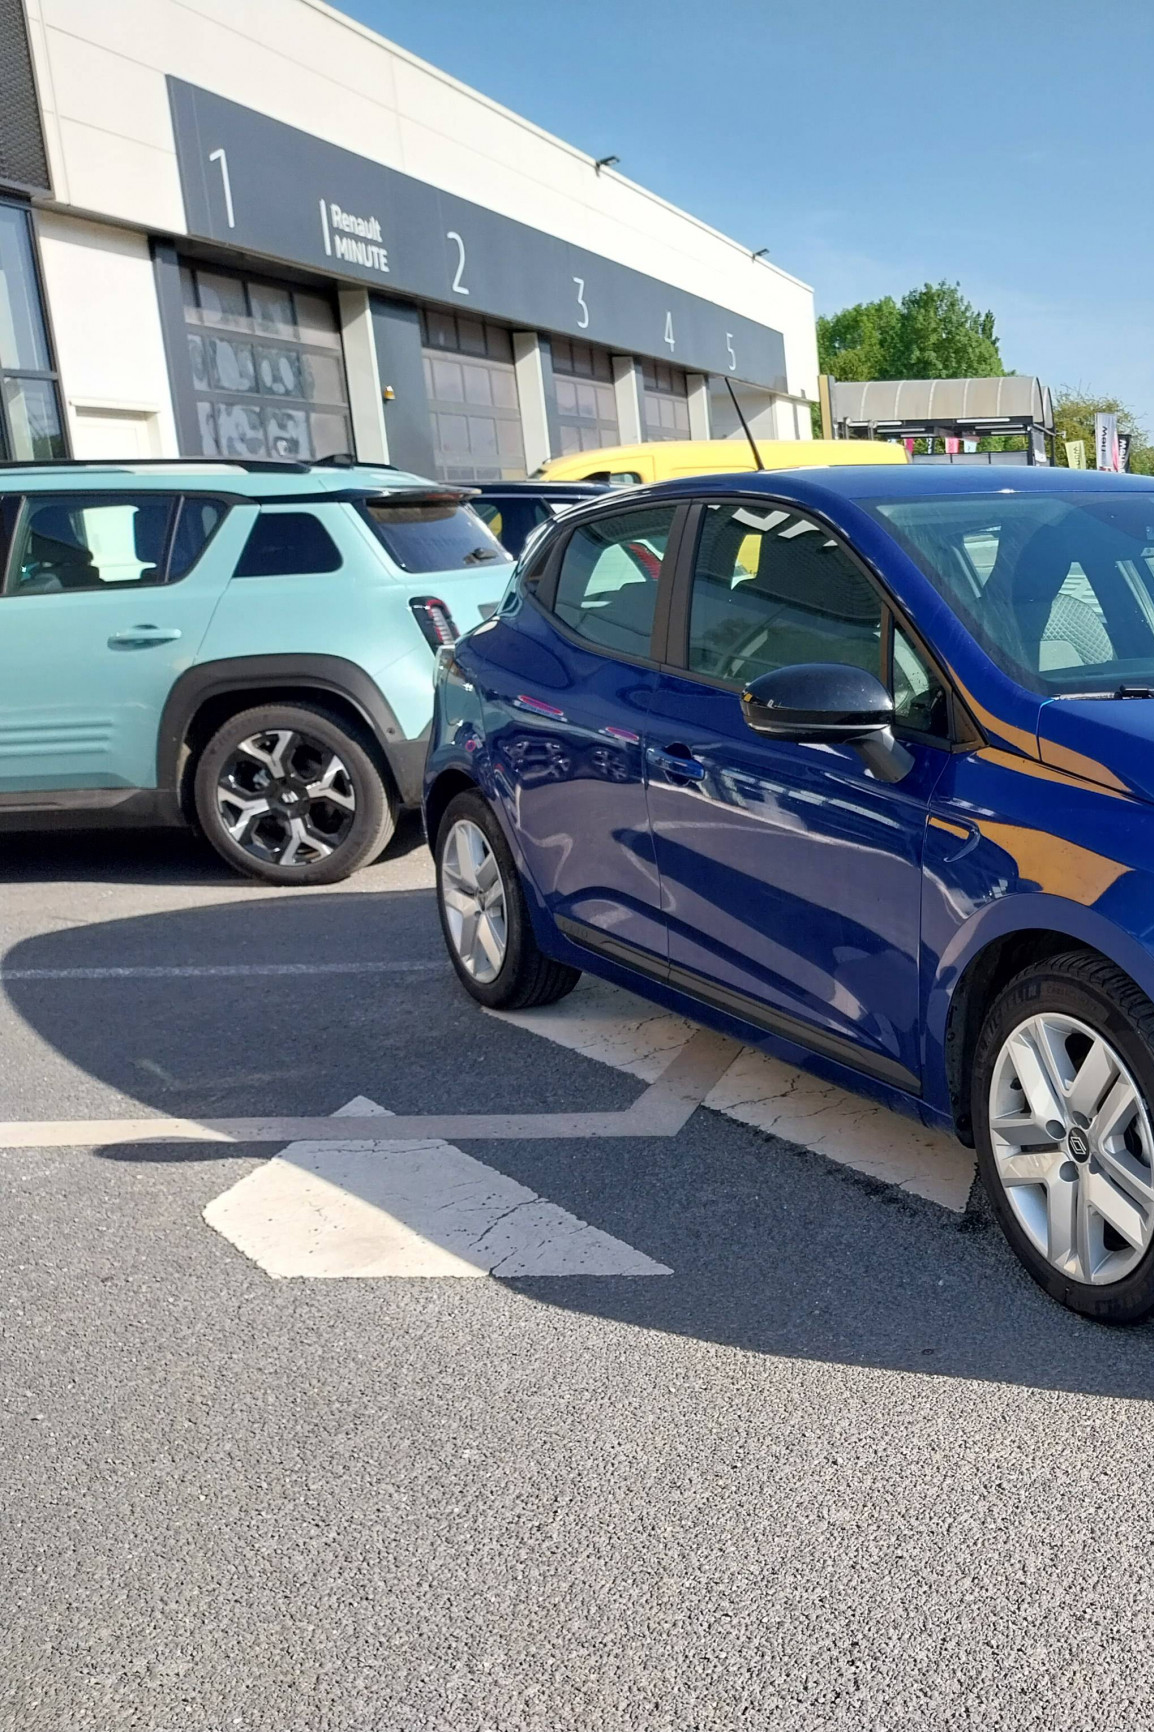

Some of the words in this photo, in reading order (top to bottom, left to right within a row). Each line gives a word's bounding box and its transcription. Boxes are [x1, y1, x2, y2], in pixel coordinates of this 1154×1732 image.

[209, 148, 235, 228] 1
[330, 203, 383, 242] Renault
[334, 234, 390, 272] MINUTE
[447, 231, 469, 295] 2
[572, 276, 589, 329] 3
[664, 311, 675, 353] 4
[726, 332, 737, 371] 5
